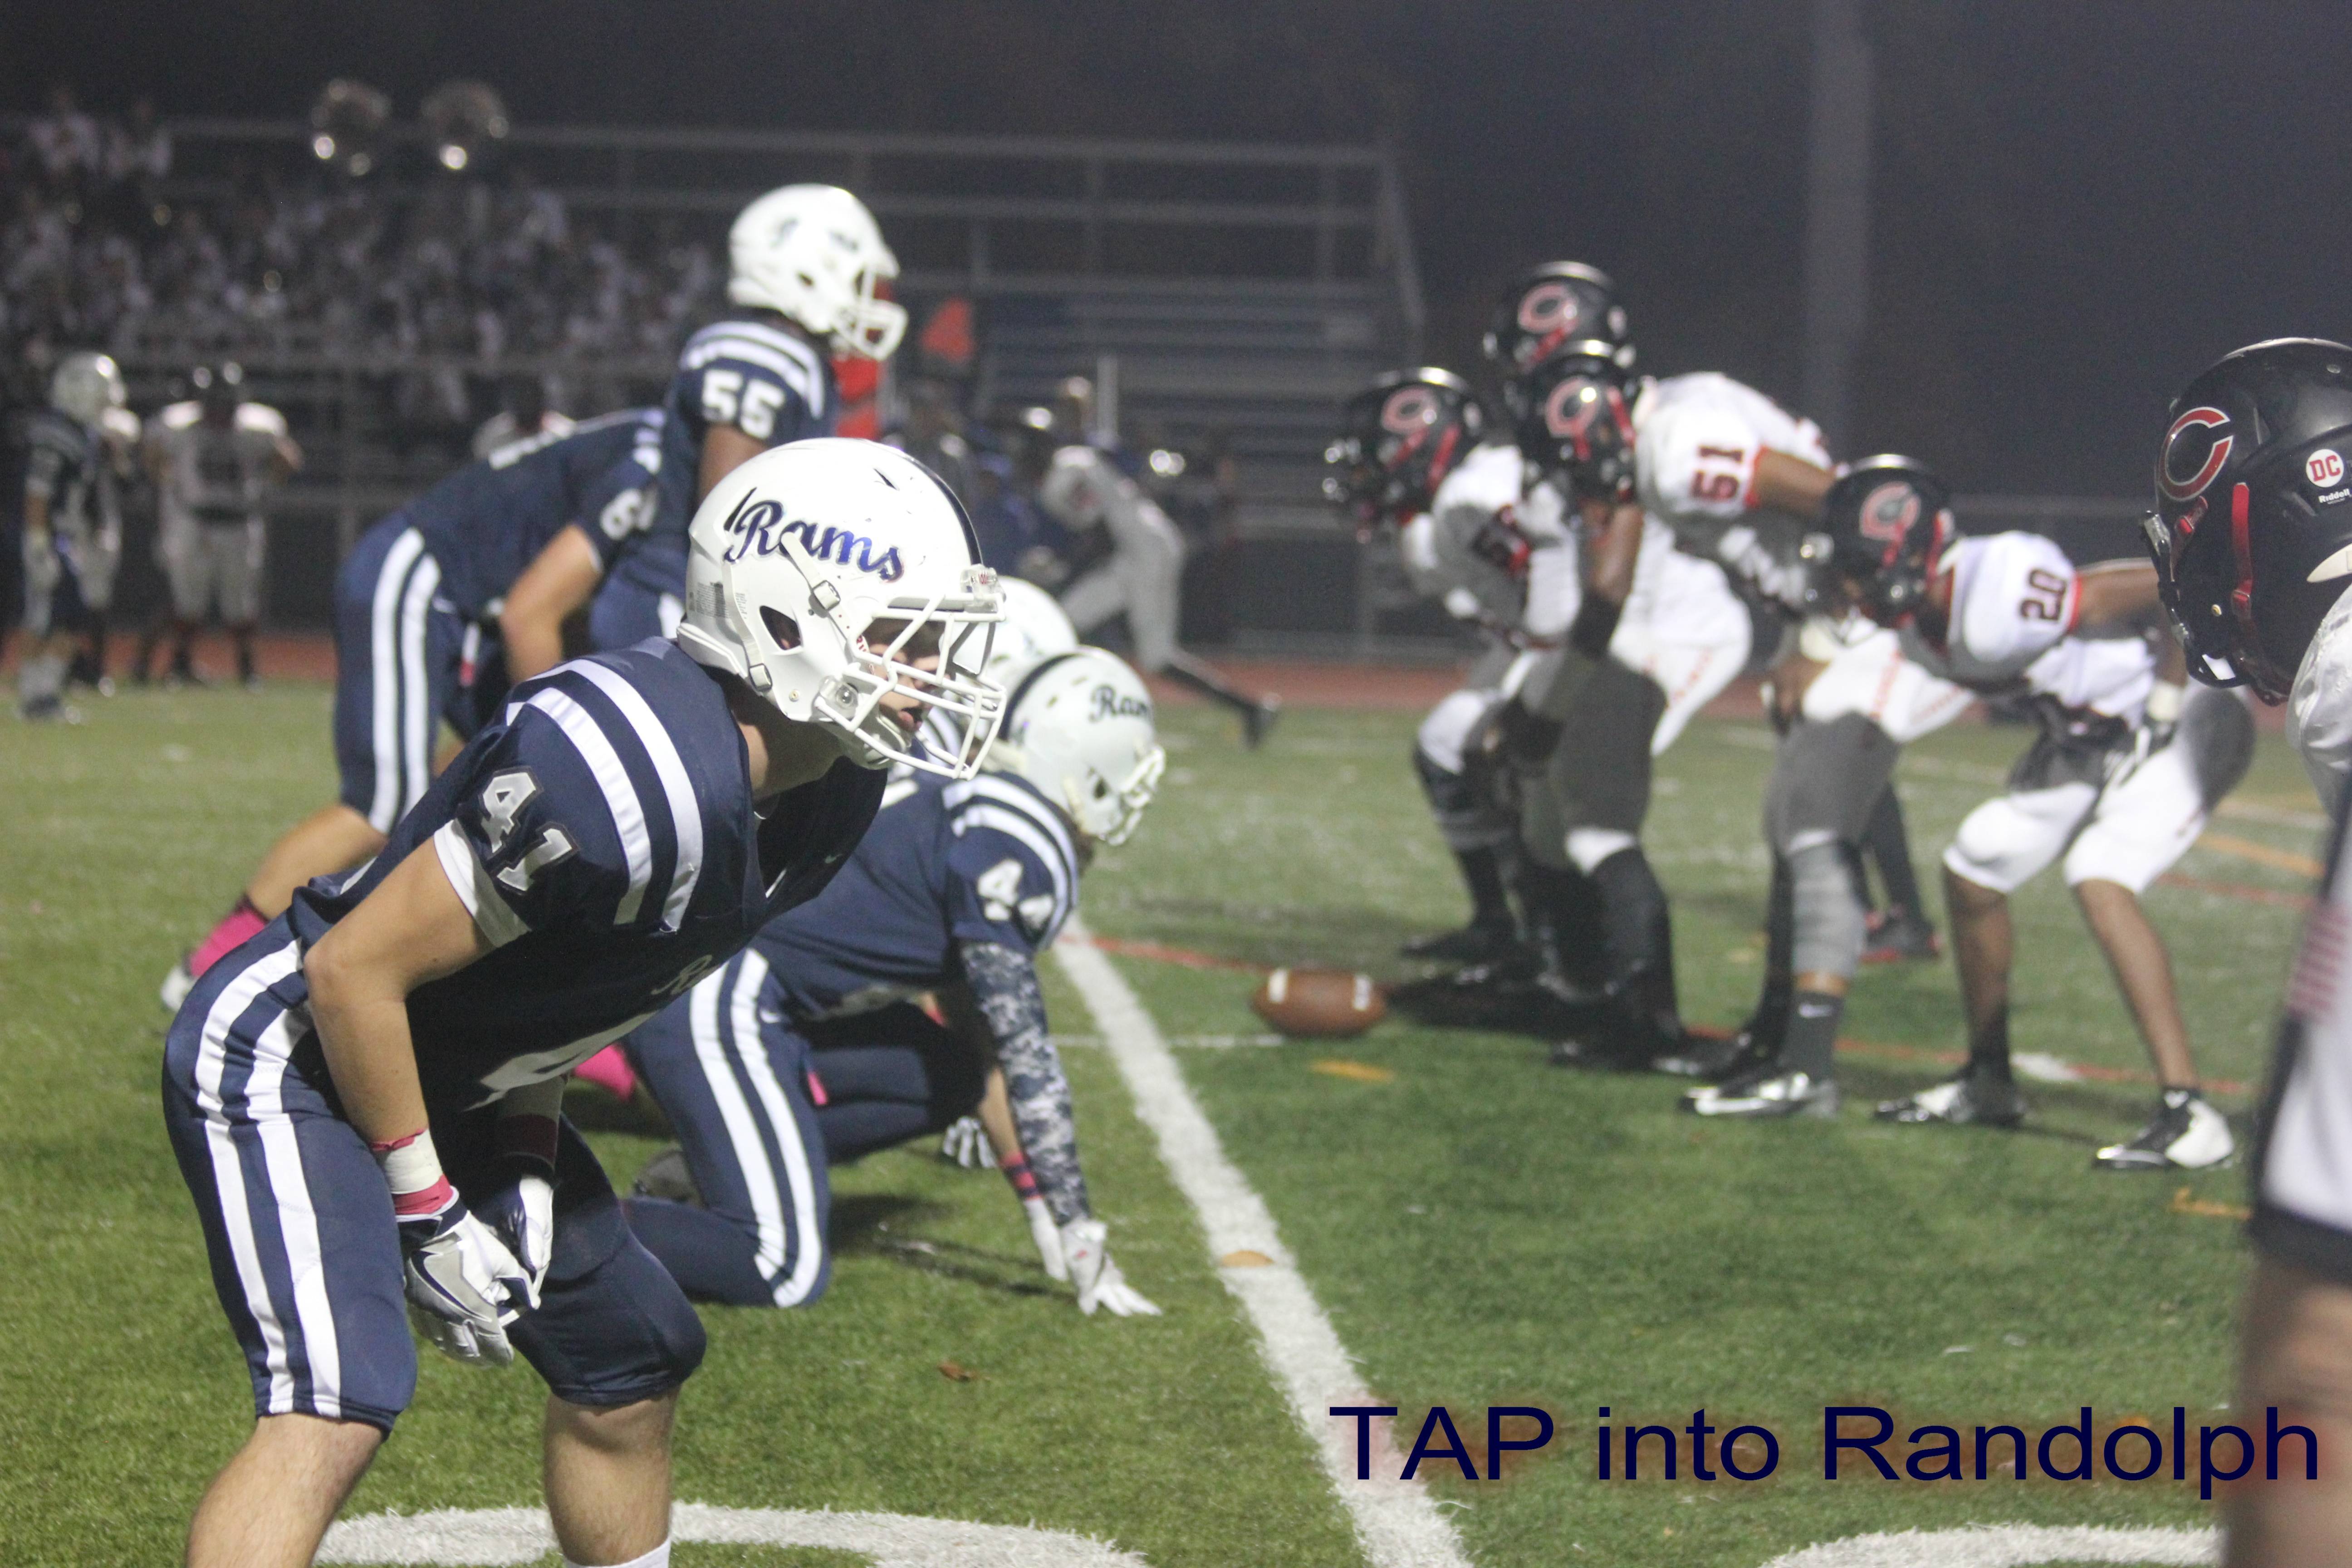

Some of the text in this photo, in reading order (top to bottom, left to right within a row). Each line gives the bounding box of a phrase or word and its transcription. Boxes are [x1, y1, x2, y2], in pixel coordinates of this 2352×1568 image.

[1692, 445, 1744, 502] 51
[2156, 407, 2233, 501] C
[2309, 455, 2341, 481] DC
[2318, 488, 2350, 503] Riddell
[723, 500, 902, 583] Rams
[2020, 568, 2068, 622] 20
[480, 771, 573, 891] 41
